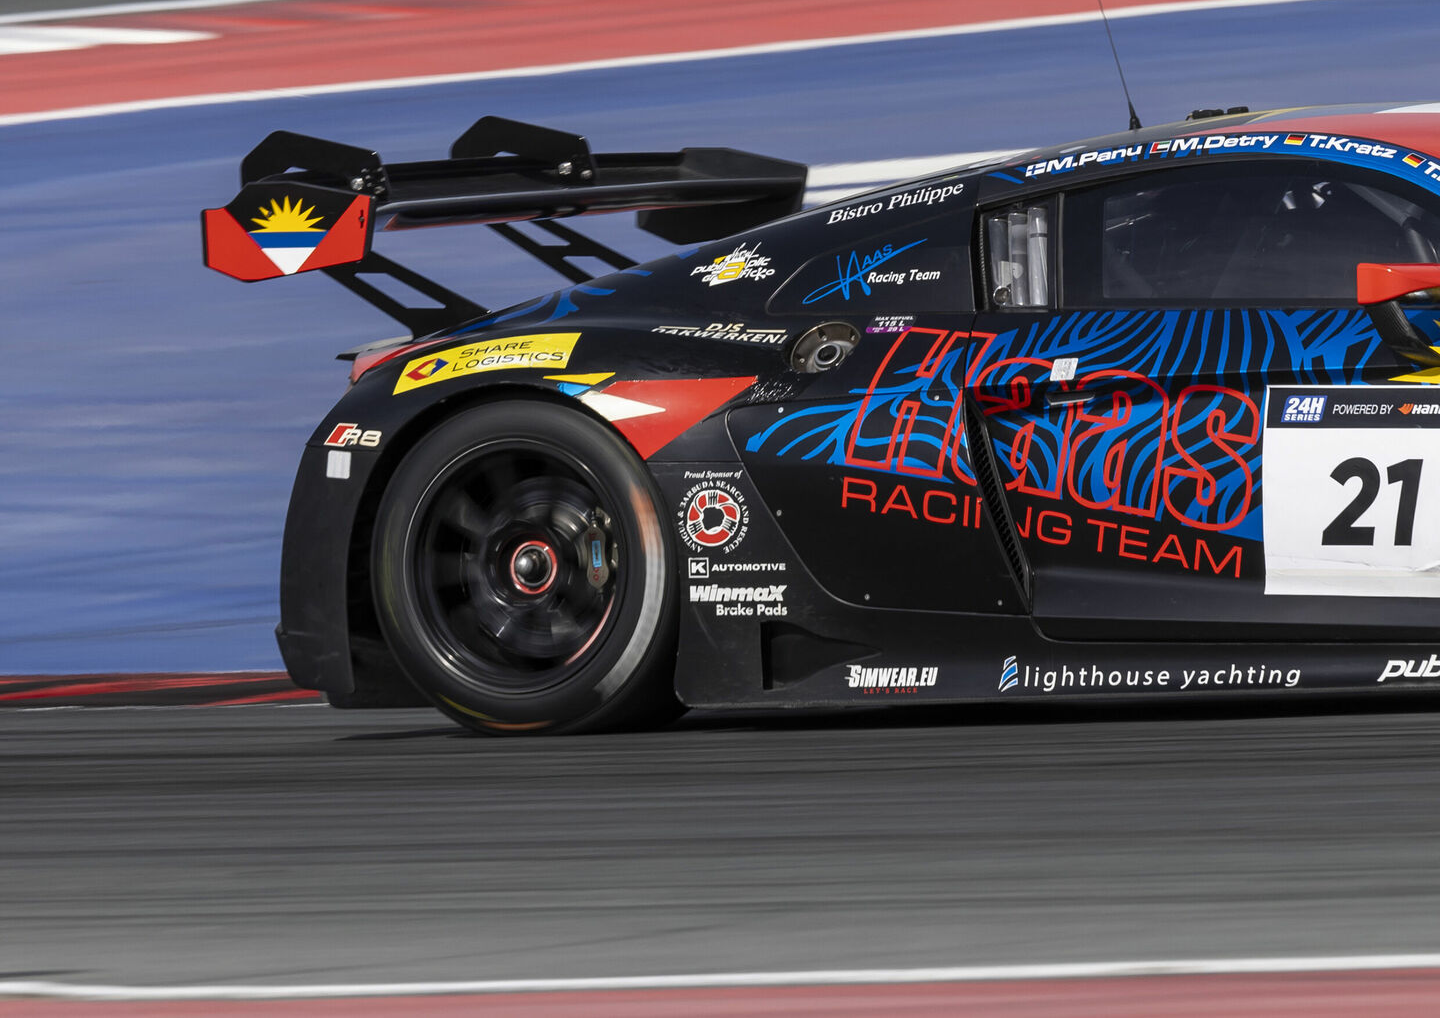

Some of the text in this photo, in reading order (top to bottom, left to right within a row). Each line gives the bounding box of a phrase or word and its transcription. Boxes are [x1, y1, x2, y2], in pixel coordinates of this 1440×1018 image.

[1171, 134, 1279, 151] M.Detry
[1309, 135, 1397, 158] T.Kratz
[1046, 145, 1142, 173] M.Panu
[826, 182, 964, 225] Bistro Philippe
[866, 268, 941, 284] Racing Team
[705, 322, 745, 333] DJS
[459, 340, 533, 359] SHARE
[452, 352, 564, 372] LOGISTICS
[1286, 397, 1325, 414] 24H
[1332, 404, 1378, 415] POWERED
[1379, 404, 1394, 415] BY
[1284, 413, 1321, 422] SERIES
[684, 469, 743, 480] Proud Sponsor of
[715, 480, 745, 504] SEARCH
[1320, 456, 1424, 547] 21
[741, 504, 750, 524] AND
[678, 520, 703, 553] ANTIGUA
[723, 525, 749, 554] RESCUE
[1087, 517, 1243, 579] TEAM
[711, 562, 786, 572] AUTOMOTIVE
[716, 602, 788, 616] Brake Pads
[844, 664, 939, 688] SIMWEAR.EU
[1023, 664, 1301, 692] lighthouse yachting
[863, 687, 890, 695] LET'S
